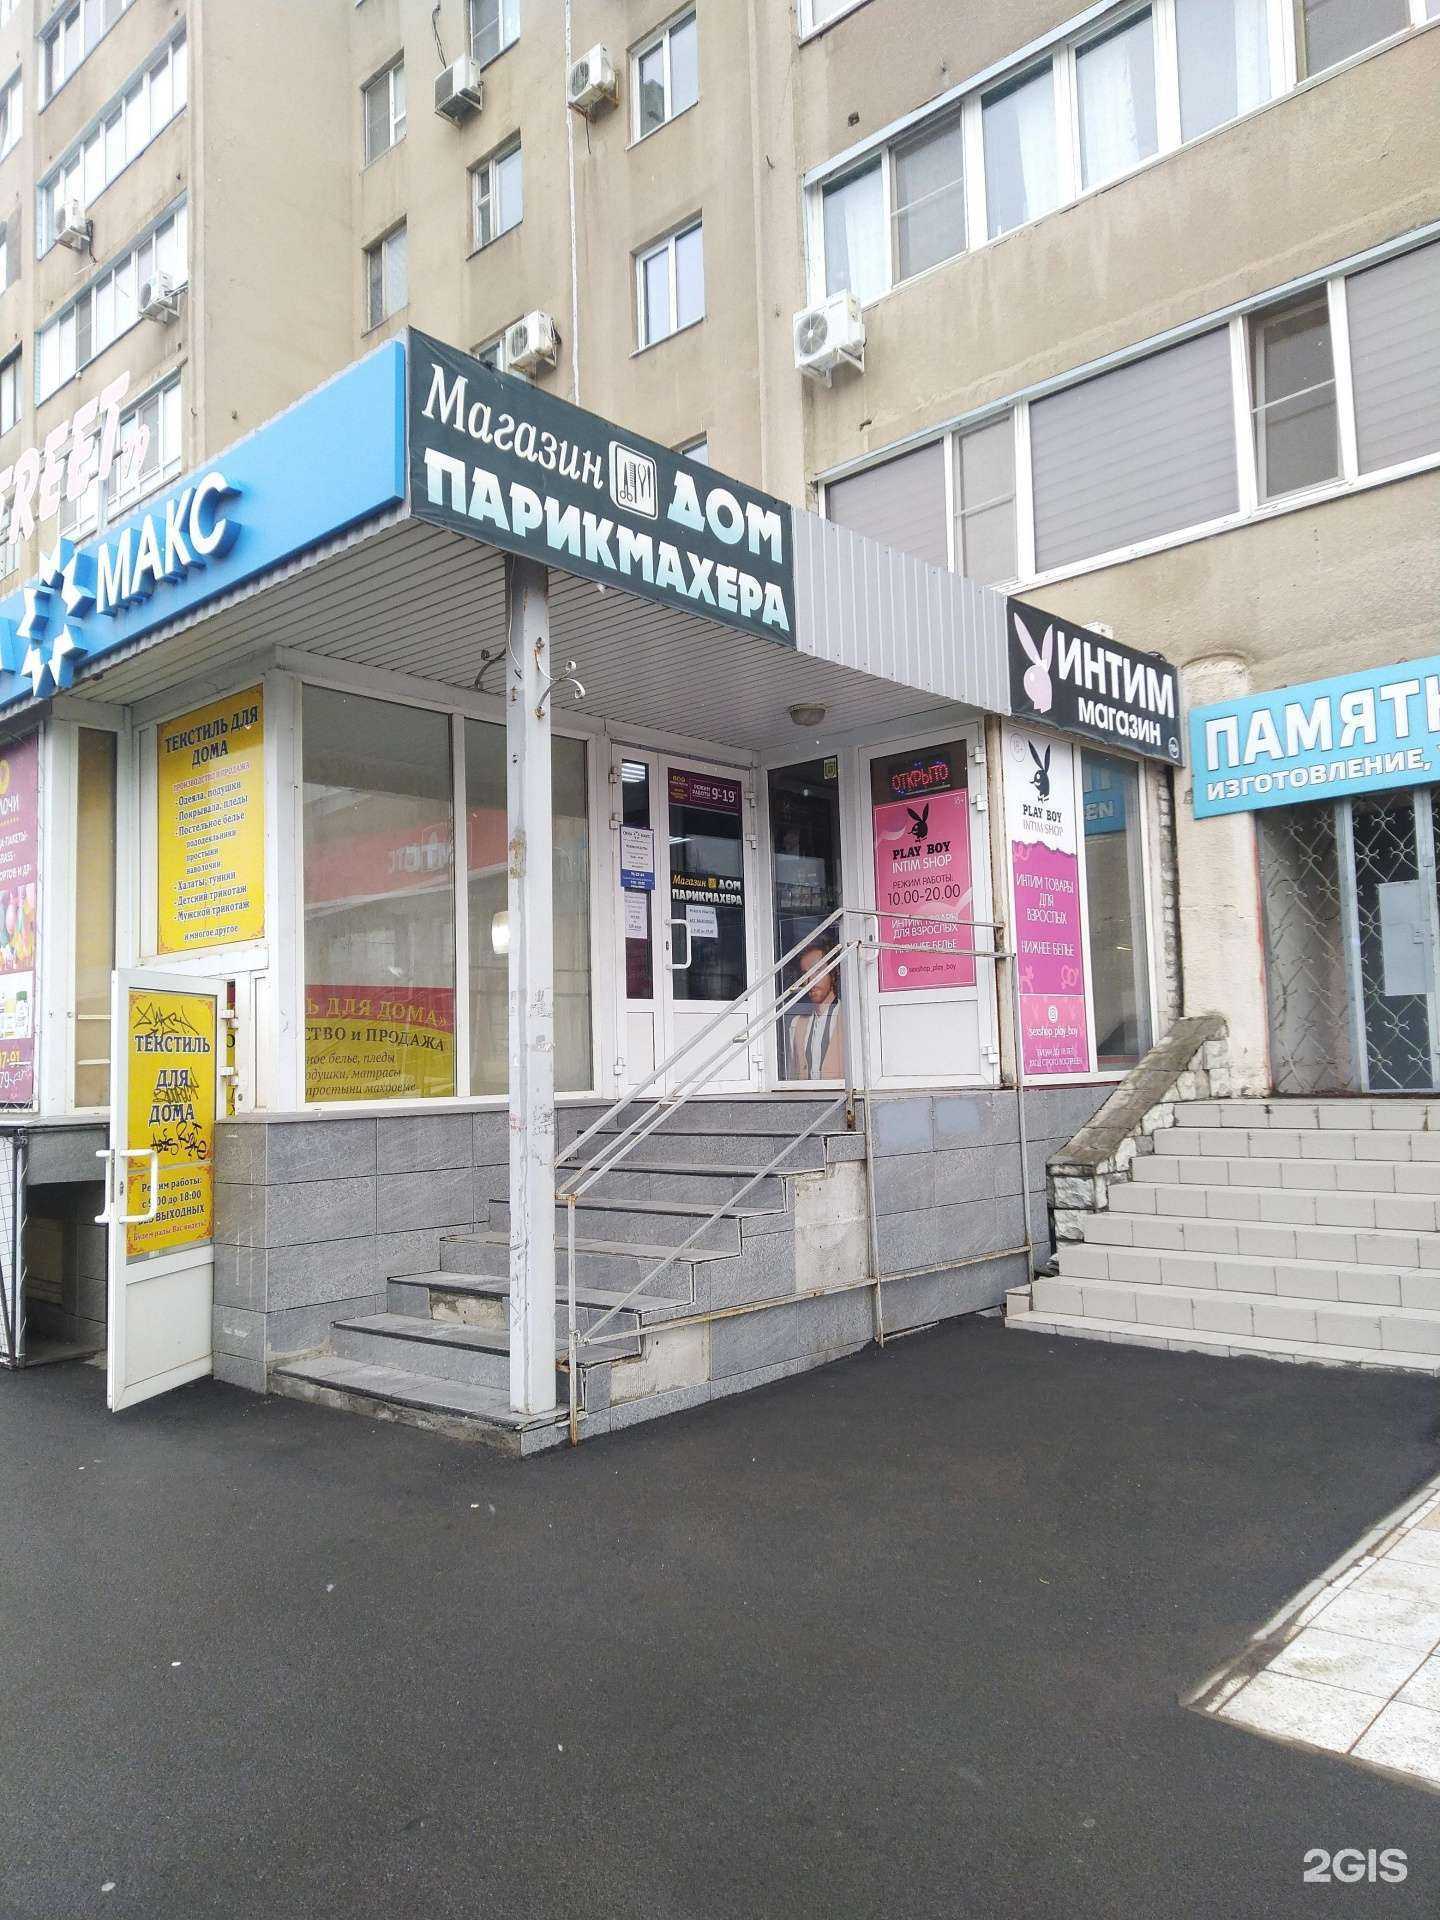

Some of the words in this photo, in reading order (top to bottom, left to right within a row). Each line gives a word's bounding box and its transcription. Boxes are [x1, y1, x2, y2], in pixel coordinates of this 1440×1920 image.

[421, 363, 604, 489] Магазин
[667, 470, 783, 564] ДОМ
[97, 472, 232, 616] МАКС
[424, 447, 790, 632] ПАРИКМАХЕРА
[1057, 630, 1174, 718] ИНТИМ
[165, 718, 228, 752] ТЕКСТИЛЬ
[231, 705, 258, 732] ДЛЯ
[1078, 697, 1161, 746] магазин
[192, 740, 228, 769] ДОМА
[892, 764, 949, 790] ОТКРЫТО
[1207, 747, 1433, 801] ИЗГОТОВЛЕНИЕ,
[207, 781, 241, 799] подушки
[223, 795, 248, 810] пледы
[223, 811, 245, 824] белье
[1023, 804, 1043, 818] PLAY
[1047, 810, 1062, 822] BOY
[1023, 819, 1043, 832] INTIM
[1045, 823, 1063, 836] SHOP
[892, 846, 921, 861] PLAY
[927, 841, 950, 856] BOY
[892, 859, 921, 874] INTIM
[923, 854, 952, 869] SHOP
[673, 875, 706, 887] Магазин
[719, 879, 741, 890] ДОМ
[893, 877, 921, 889] РЕЖИМ
[1016, 872, 1043, 888] ИНТИМ
[1045, 877, 1074, 894] ТОВАРЫ
[209, 884, 247, 901] трикотаж
[672, 889, 742, 905] ПАРИКМАХЕРА
[888, 883, 961, 906] 10.00-20.00
[1040, 892, 1053, 907] ДЛЯ
[211, 900, 250, 916] трикотаж
[1026, 907, 1067, 924] ВЗРОСЛЫХ
[894, 927, 911, 939] ДЛЯ
[912, 922, 958, 937] ВЗРОСЛЫХ
[933, 938, 957, 951] БЕЛЬЕ
[1021, 939, 1050, 955] НИЖНЕЕ
[1053, 942, 1074, 957] БЕЛЬЕ
[326, 997, 371, 1019] ДЛЯ
[134, 1035, 210, 1053] ТЕКСТИЛЬ
[351, 1030, 361, 1041] и
[366, 1028, 445, 1052] ПРОДАЖА
[363, 1051, 395, 1064] пледы
[157, 1069, 188, 1088] ДЛЯ
[149, 1104, 195, 1127] ДОМА
[142, 1180, 170, 1193] Реим
[168, 1196, 178, 1205] до
[180, 1189, 202, 1203] 18:00
[156, 1204, 205, 1223] ВЫХОДНЫХ
